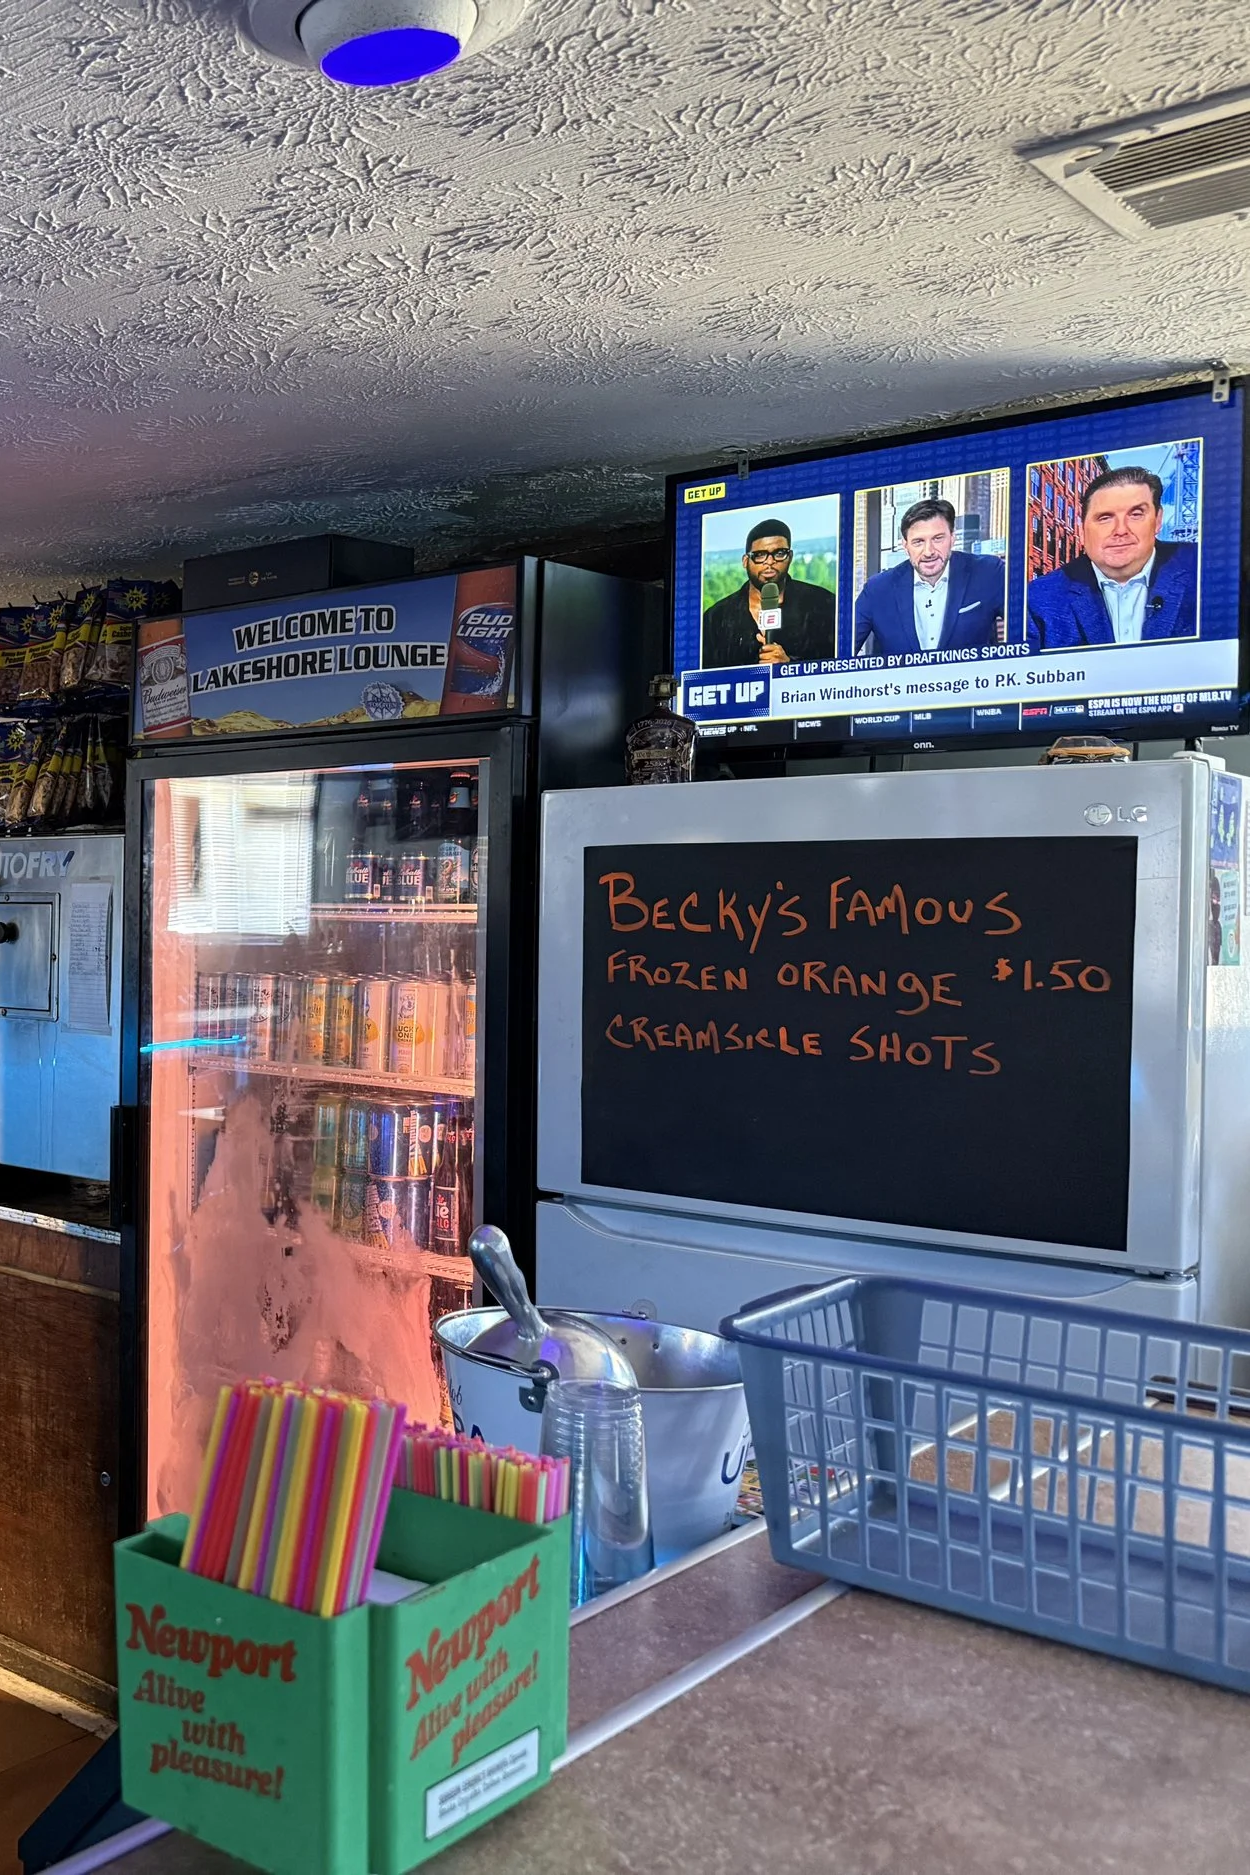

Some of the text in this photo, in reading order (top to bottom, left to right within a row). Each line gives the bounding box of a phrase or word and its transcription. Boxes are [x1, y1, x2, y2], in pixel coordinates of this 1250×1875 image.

[688, 486, 722, 500] GET UP
[235, 606, 394, 651] WELCOME TO
[456, 624, 514, 638] LIGHT
[466, 613, 513, 626] BUD
[192, 644, 446, 694] LAKESHORE LOUNGE
[780, 643, 1030, 676] GET UP PRESENTED BY DRAFTKINGS SPORTS
[142, 685, 186, 705] Budweiser
[689, 681, 765, 706] GET UP
[781, 669, 1086, 704] Brian Windhorst's message to P.K. Subban
[1088, 690, 1232, 709] ESPN IS NOW THE HOME OF MLB.TV
[854, 714, 900, 725] WORLD CUP
[913, 712, 932, 721] MLB
[976, 708, 1002, 716] WNBA
[1023, 707, 1048, 717] ESPN
[1088, 705, 1172, 717] STREAM IN THE ESPN APP
[1117, 804, 1148, 823] LG
[829, 875, 1023, 936] FAMOUS
[607, 949, 748, 991] FROZEN
[991, 957, 1112, 993] $1.50
[605, 1013, 1002, 1076] CREAMSICLE SHOTS
[125, 1603, 298, 1683] Newport
[405, 1551, 541, 1712] Newport
[133, 1669, 206, 1714] Alive
[409, 1646, 509, 1762] Alive with
[451, 1648, 539, 1768] pleasure!
[181, 1716, 246, 1757] with
[149, 1739, 285, 1801] pleasure!
